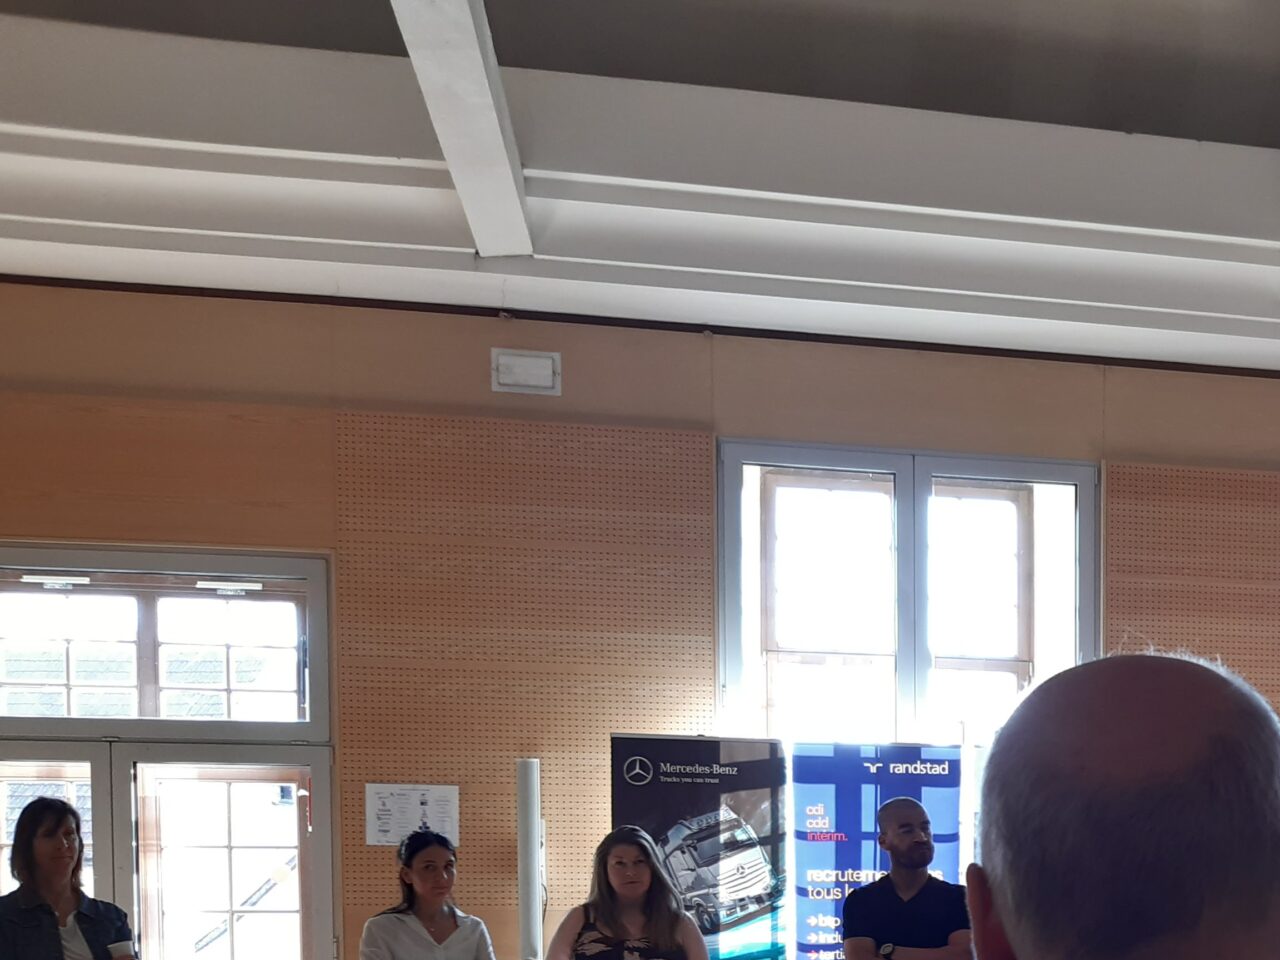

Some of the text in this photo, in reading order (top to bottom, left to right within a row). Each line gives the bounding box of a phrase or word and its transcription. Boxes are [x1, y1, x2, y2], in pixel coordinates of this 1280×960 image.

[660, 763, 738, 775] Mercedes-Benz
[889, 761, 949, 775] randstad
[807, 803, 824, 815] cdi
[807, 816, 829, 828] cdd
[807, 868, 889, 882] recruteme
[808, 885, 842, 900] tous
[818, 930, 844, 944] indu
